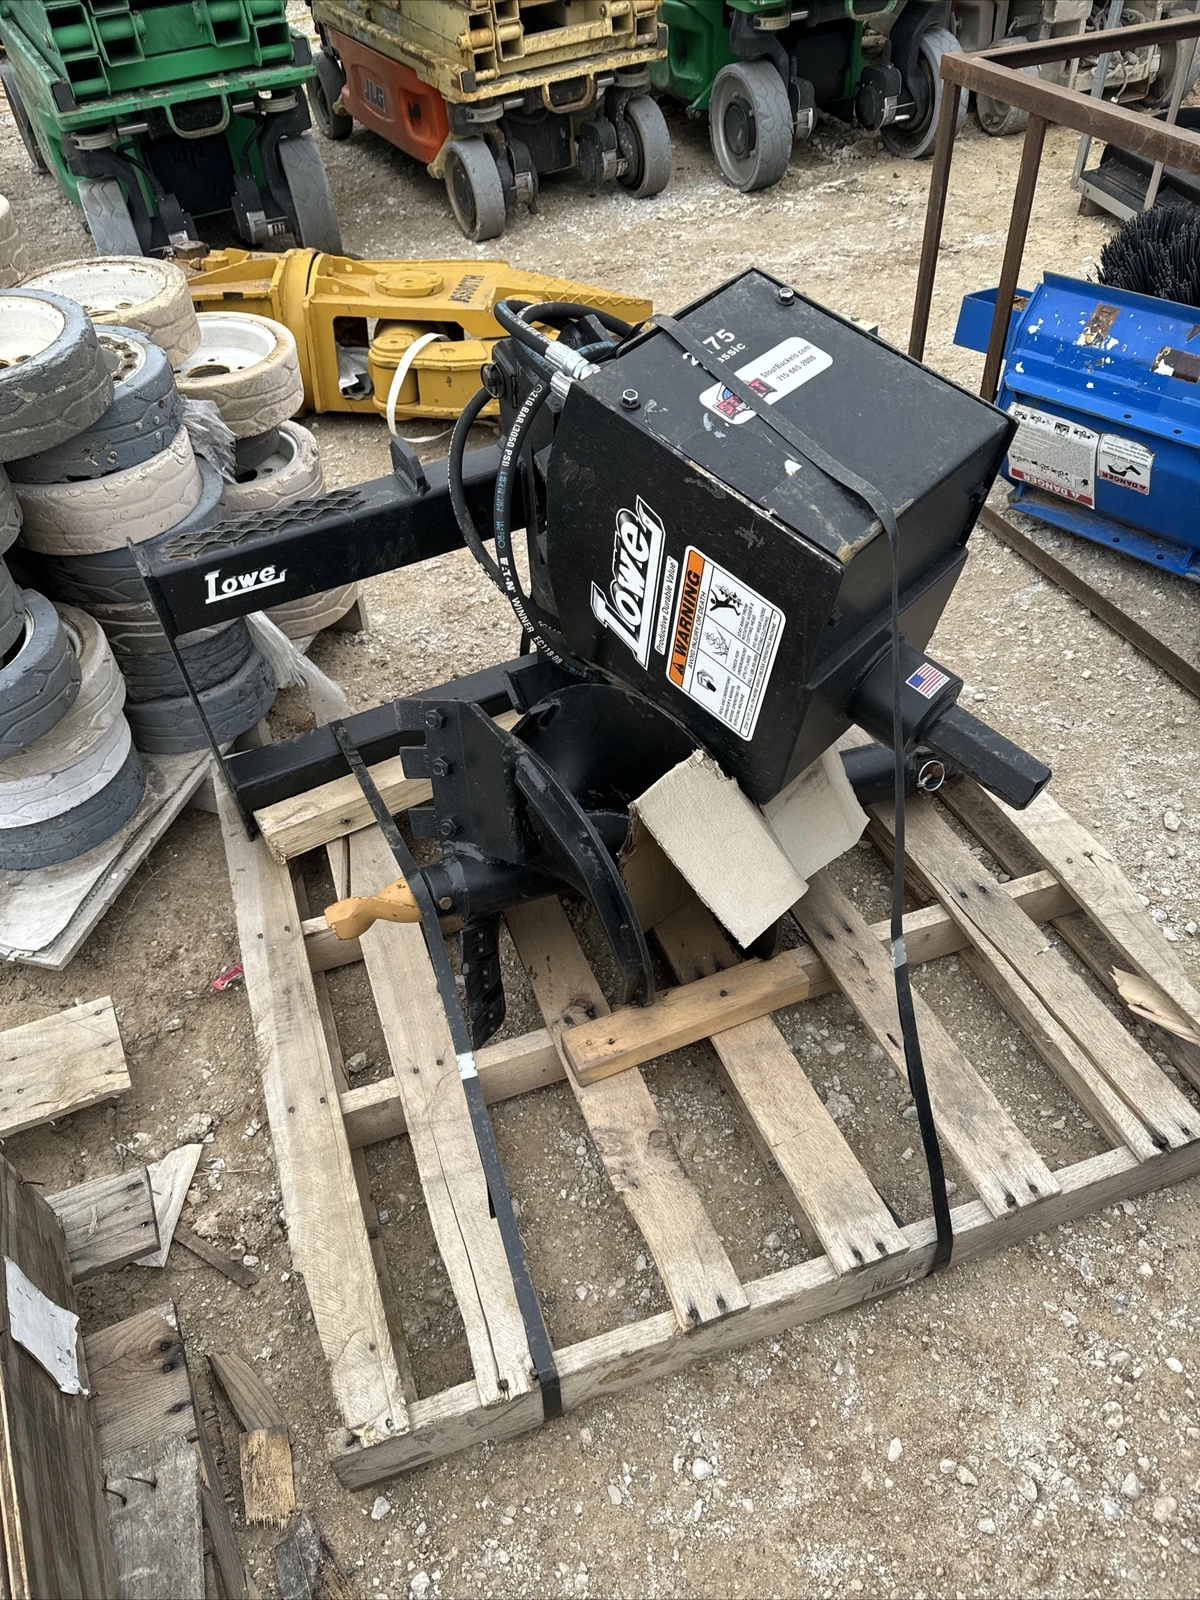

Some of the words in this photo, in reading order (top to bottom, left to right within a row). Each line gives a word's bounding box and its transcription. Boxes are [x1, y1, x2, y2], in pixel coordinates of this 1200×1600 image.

[364, 78, 386, 112] JLG
[682, 328, 736, 367] 275
[759, 344, 812, 378] StoutBuckets.com
[775, 354, 817, 382] 715-665-2000
[526, 392, 538, 406] 210
[718, 380, 767, 414] STT
[516, 407, 530, 424] BAR
[1022, 472, 1067, 495] DANGER
[1102, 471, 1137, 488] DANGER
[205, 565, 288, 604] Lowe
[591, 495, 665, 671] Lowe
[512, 597, 535, 634] WINNER
[655, 611, 666, 653] Productive
[661, 580, 672, 615] Durable
[674, 567, 700, 659] WARNING
[697, 590, 706, 615] DEATH
[695, 613, 702, 626] OR
[691, 625, 700, 649] INJURY
[687, 648, 695, 669] AVOID
